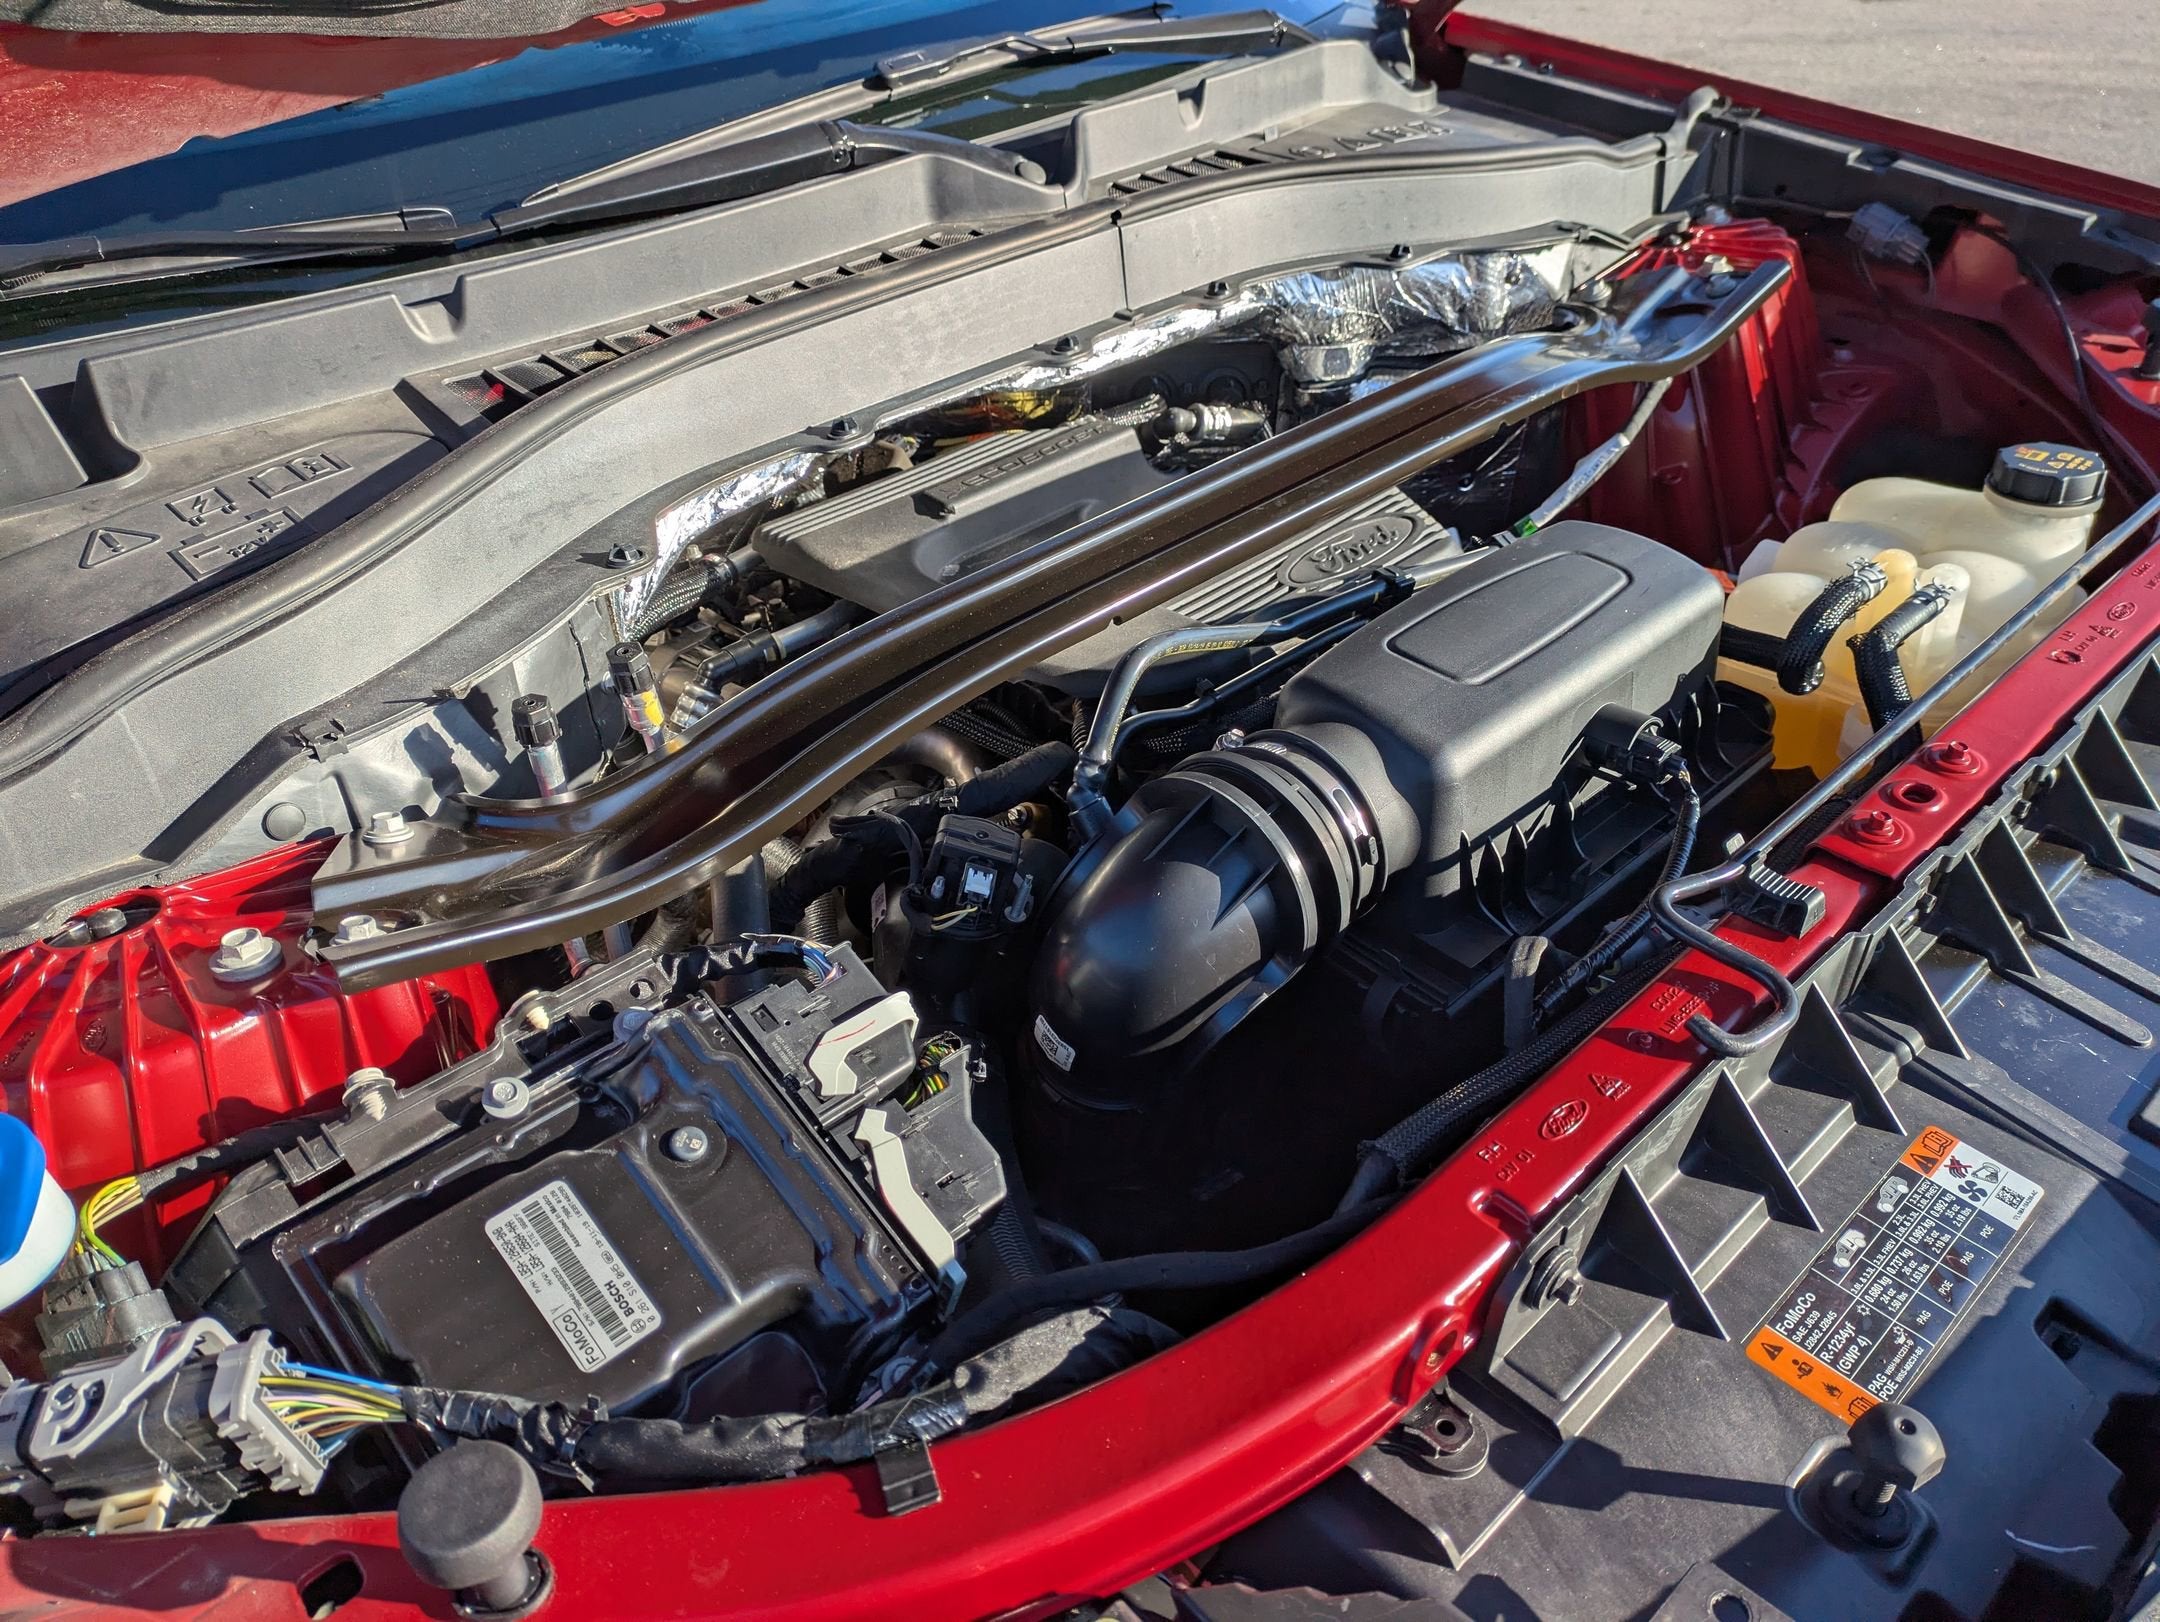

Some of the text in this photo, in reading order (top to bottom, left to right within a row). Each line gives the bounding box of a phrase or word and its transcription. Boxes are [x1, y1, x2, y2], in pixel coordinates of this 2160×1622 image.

[226, 535, 270, 559] 12V
[1310, 525, 1399, 574] Ford
[1546, 1103, 1586, 1137] Ford
[1908, 1178, 1931, 1204] 3.3L FHEV
[1924, 1183, 1939, 1199] PHEV
[540, 1193, 558, 1214] Mexico
[1929, 1191, 1956, 1217] 0.992 kg
[1944, 1208, 1956, 1218] 35
[1907, 1216, 1936, 1244] 0.992 kg
[1952, 1213, 1967, 1227] 2.19
[1979, 1223, 1995, 1238] POE
[558, 1218, 582, 1248] Assembled
[1923, 1234, 1935, 1245] 35
[1872, 1238, 1896, 1265] 3.3L FHEV
[1931, 1239, 1946, 1254] 2.19
[1959, 1250, 1975, 1266] PAG
[1885, 1246, 1914, 1275] 0.737 kg
[1901, 1265, 1913, 1275] 26
[1863, 1273, 1892, 1303] 0.680 kg
[1909, 1270, 1923, 1284] 1.63
[1937, 1278, 1954, 1295] POE
[603, 1279, 635, 1317] BOSCH
[634, 1297, 649, 1314] 261
[1879, 1293, 1891, 1304] 24
[1887, 1298, 1903, 1313] 1.50
[1774, 1292, 1817, 1335] FoMoCo
[1915, 1309, 1932, 1325] PAG
[1791, 1309, 1821, 1343] SAE J639
[1802, 1309, 1838, 1350] J2842 J2845
[558, 1313, 600, 1364] FoMoCo
[1818, 1321, 1859, 1364] R-1234yf
[1834, 1333, 1873, 1375] (GWP 4)
[1866, 1372, 1888, 1393] PAG
[1877, 1378, 1899, 1401] POE
